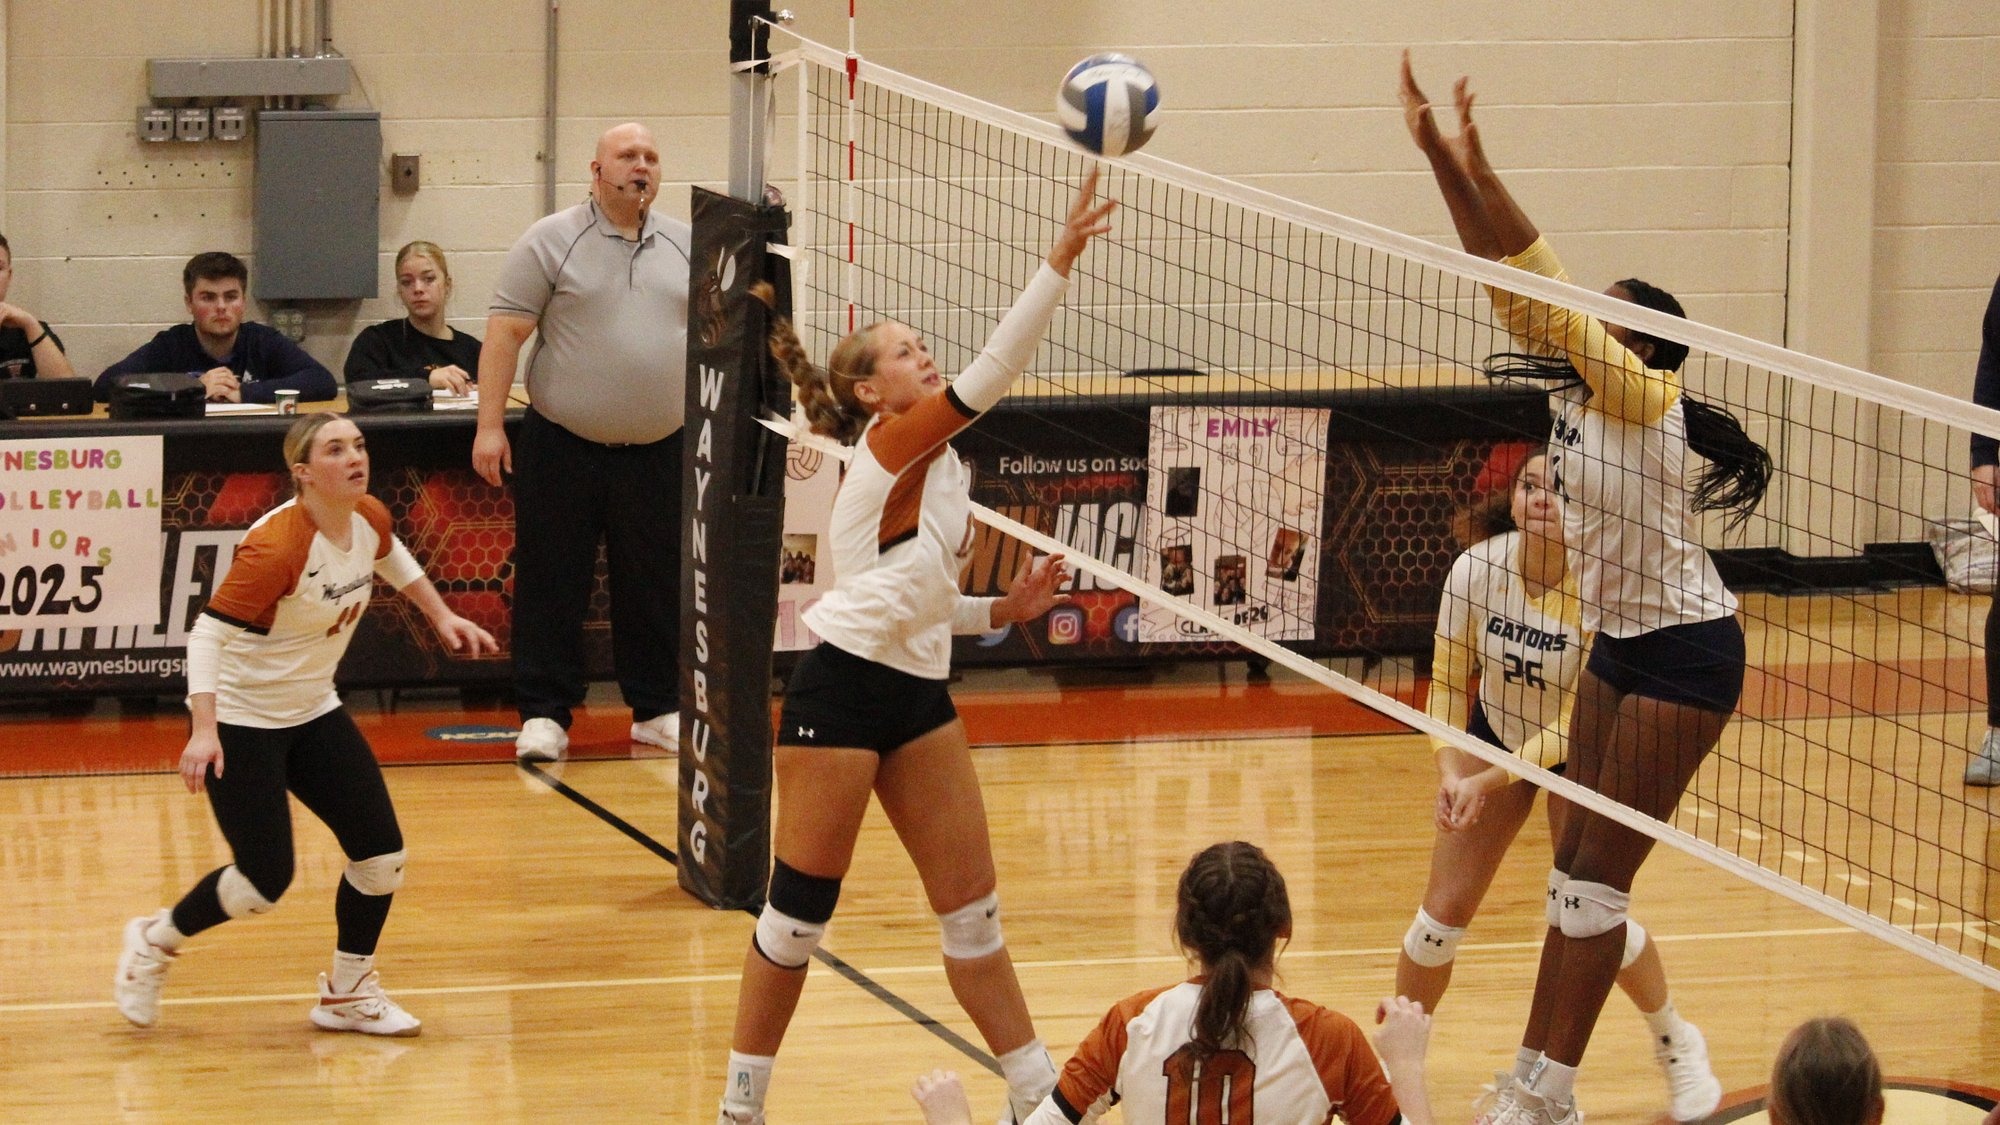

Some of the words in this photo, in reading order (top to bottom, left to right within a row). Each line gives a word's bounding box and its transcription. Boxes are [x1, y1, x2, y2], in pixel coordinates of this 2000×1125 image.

[1207, 418, 1278, 438] EMILY
[0, 449, 122, 471] NESBURG
[1000, 455, 1062, 475] Follow
[1066, 458, 1087, 473] us
[1091, 458, 1115, 473] on
[690, 364, 724, 865] WAYNESBURG
[1488, 616, 1567, 652] GATORS
[1163, 1041, 1256, 1125] 10
